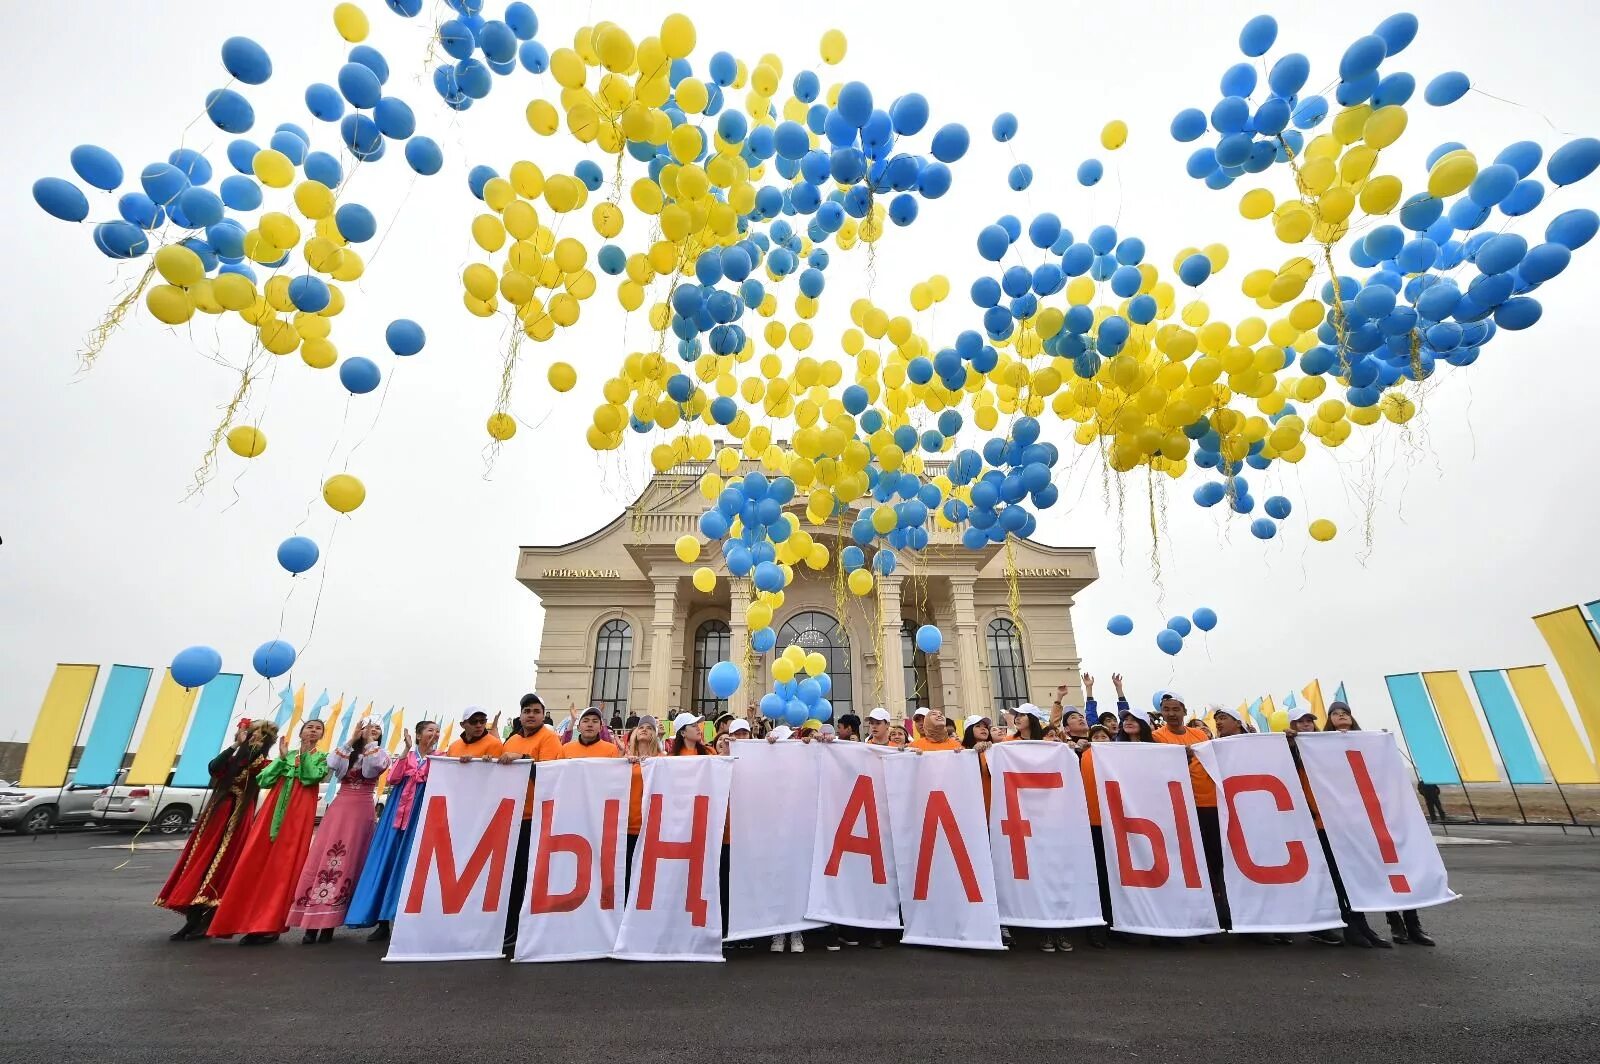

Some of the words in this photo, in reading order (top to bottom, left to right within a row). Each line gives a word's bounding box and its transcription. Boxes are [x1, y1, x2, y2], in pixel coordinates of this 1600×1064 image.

[542, 567, 620, 578] МЕЙРАМХАНА
[1003, 567, 1071, 577] RSTAURANT
[404, 794, 710, 927] МЫҢ
[824, 750, 1411, 903] АЛҒЫС!
